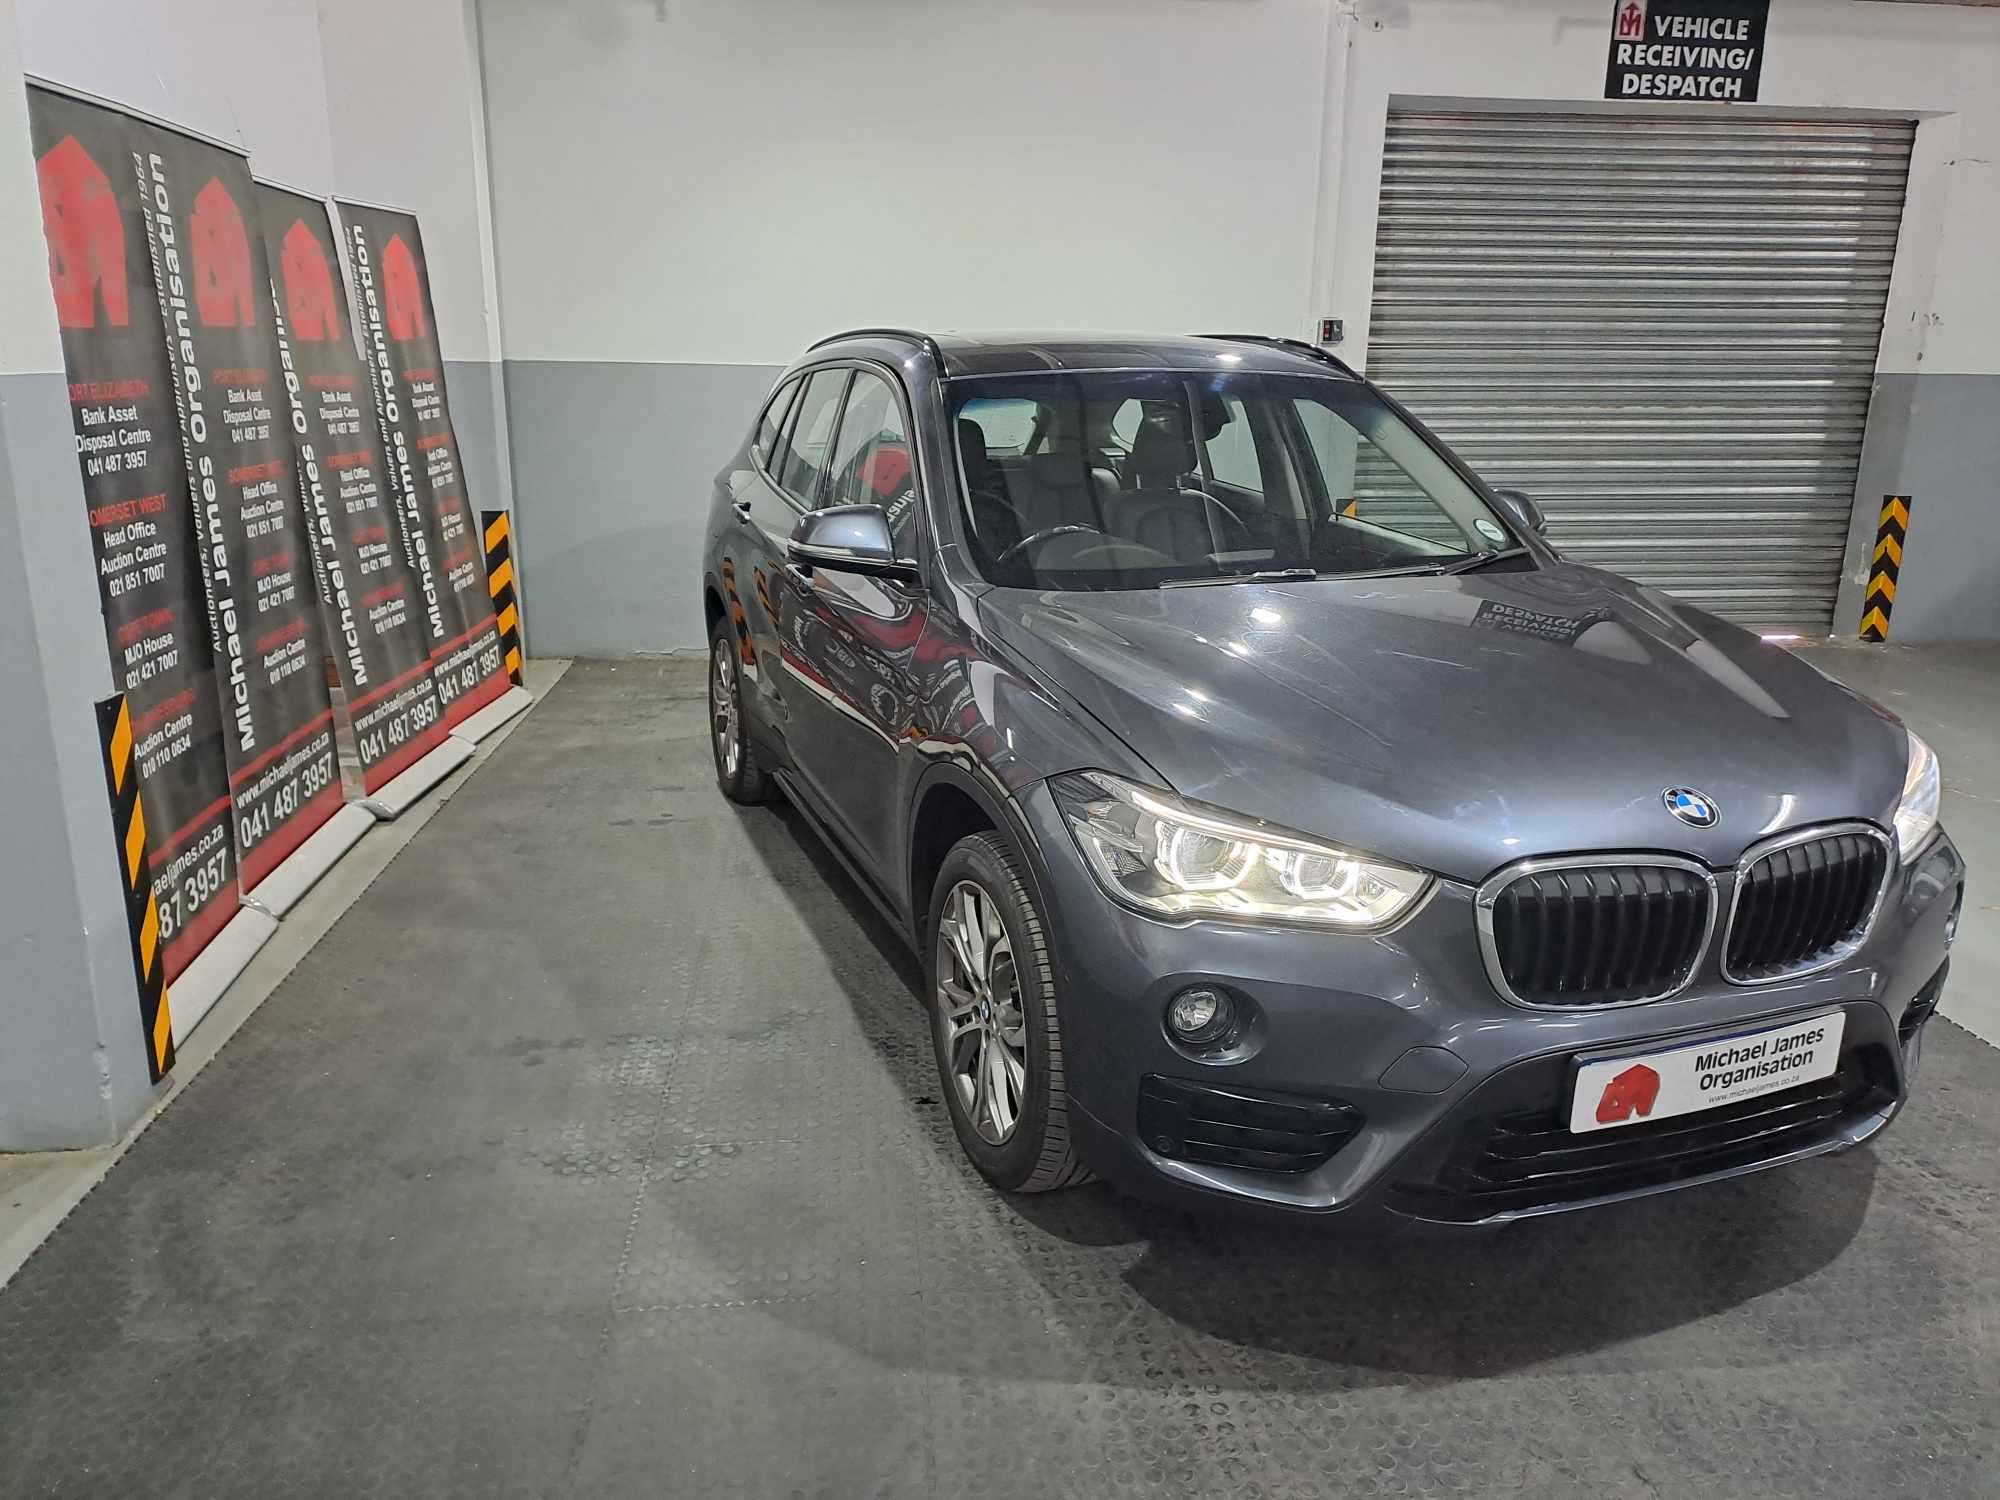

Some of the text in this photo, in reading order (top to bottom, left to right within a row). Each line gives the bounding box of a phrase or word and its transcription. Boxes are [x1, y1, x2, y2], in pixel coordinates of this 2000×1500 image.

[1654, 15, 1750, 41] VEHICLE
[1616, 43, 1754, 70] RECEIVING/
[1622, 73, 1742, 98] DESPATCH
[353, 225, 399, 423] Organisation
[81, 405, 138, 426] Bank Asset
[75, 428, 151, 454] Disposal Centre
[149, 152, 256, 752] Michael James Organisation
[87, 450, 147, 477] 041 487 3957
[393, 431, 420, 523] James
[90, 500, 137, 527] OMERSET
[301, 444, 336, 552] James
[103, 521, 157, 550] Head Office
[101, 542, 167, 576] Auction Centre
[109, 563, 165, 597] 021 851 7007
[200, 547, 223, 653] Auctioneers,
[411, 530, 444, 639] Michael
[144, 631, 174, 656] House
[326, 560, 368, 687] Michael
[126, 650, 178, 690] 021 421 7007
[438, 645, 501, 705] 041 487 3957
[133, 713, 193, 761] Auction Centre
[360, 695, 437, 765] 041 487 3957
[240, 751, 332, 848] 041 487 3957
[185, 848, 227, 912] 3957
[1695, 1028, 1824, 1072] Michael James
[1699, 1050, 1814, 1091] Organisation
